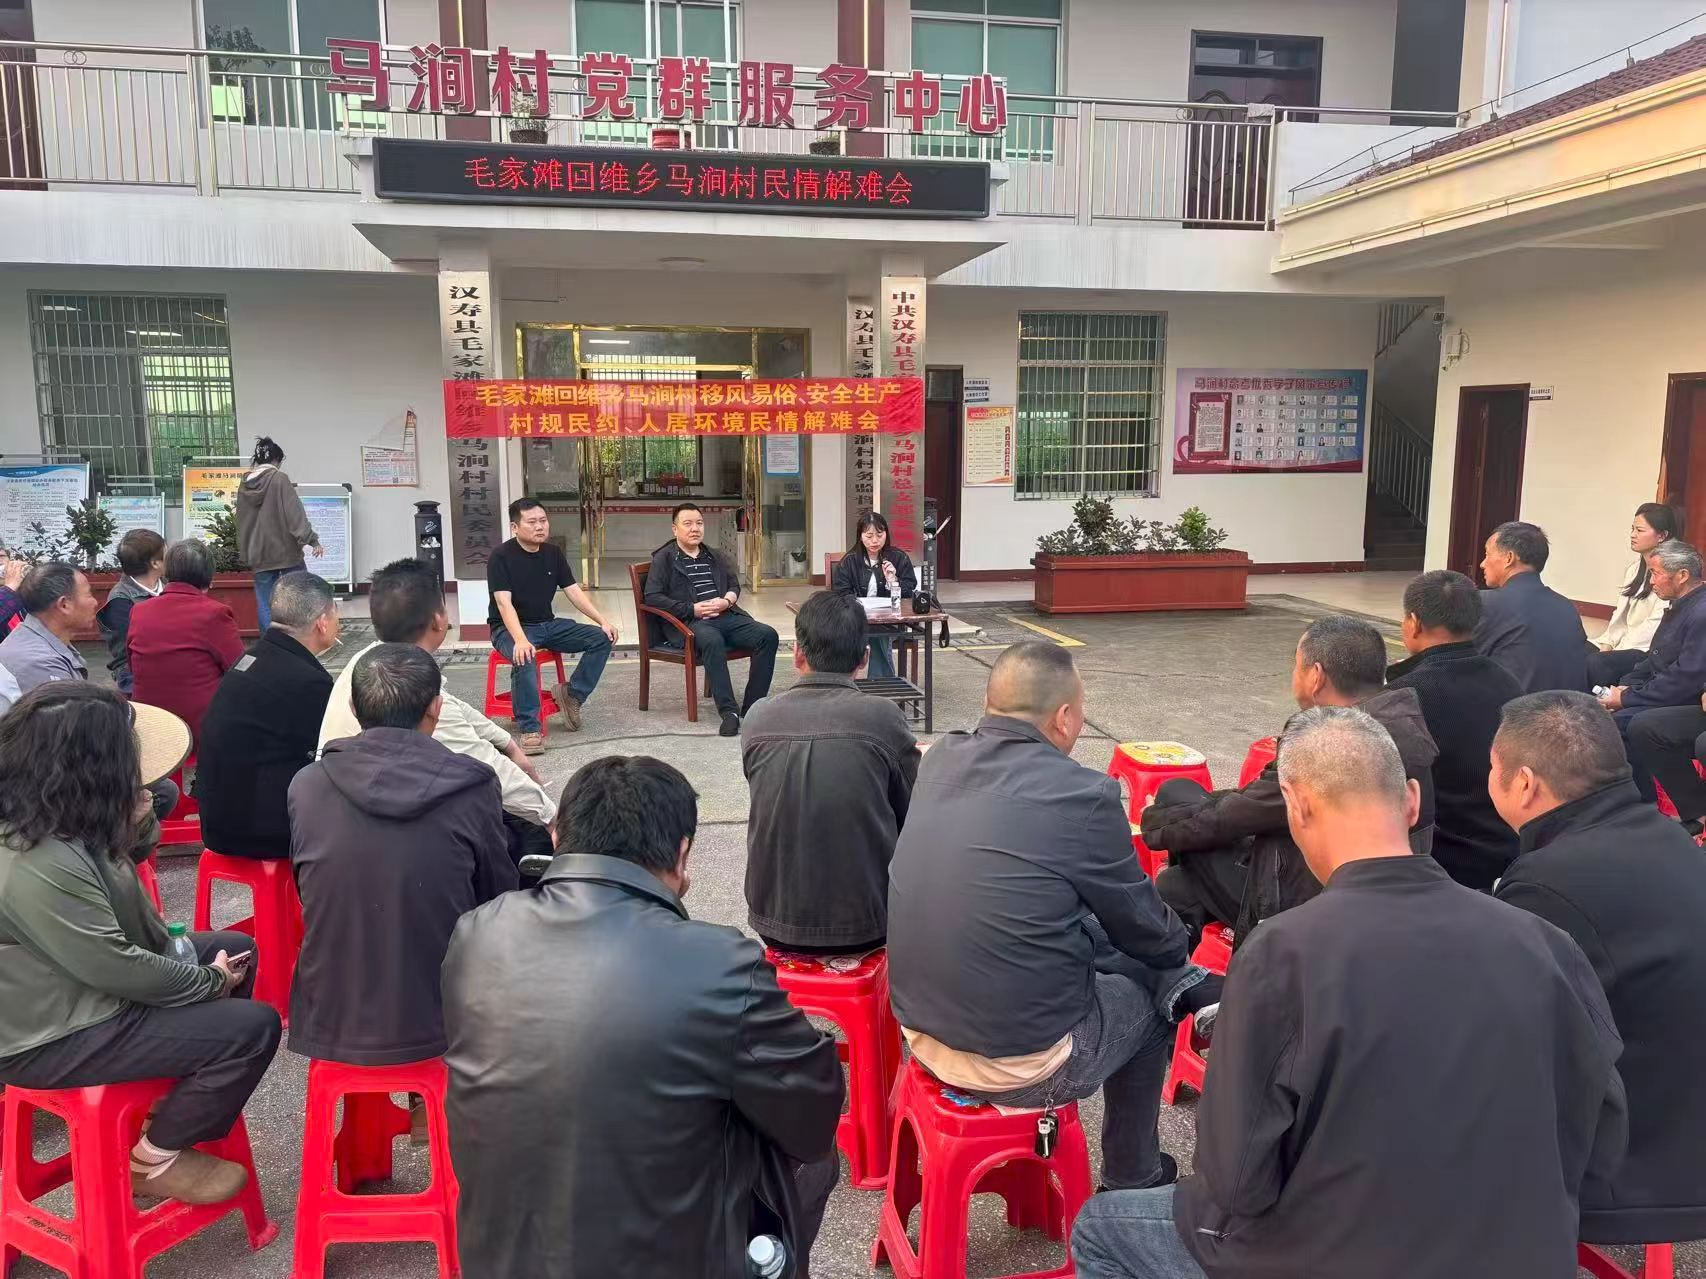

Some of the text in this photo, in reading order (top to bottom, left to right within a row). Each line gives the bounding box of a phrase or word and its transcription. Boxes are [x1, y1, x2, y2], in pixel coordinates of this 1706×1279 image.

[326, 37, 1008, 135] 马涧村党群服务中心
[463, 157, 912, 205] 毛家滩回维乡马涧村民情解难会
[476, 382, 902, 407] 毛家滩回维乡马涧村移风易俗、安全生产
[509, 410, 880, 435] 村规民约、人居环境民情解难会
